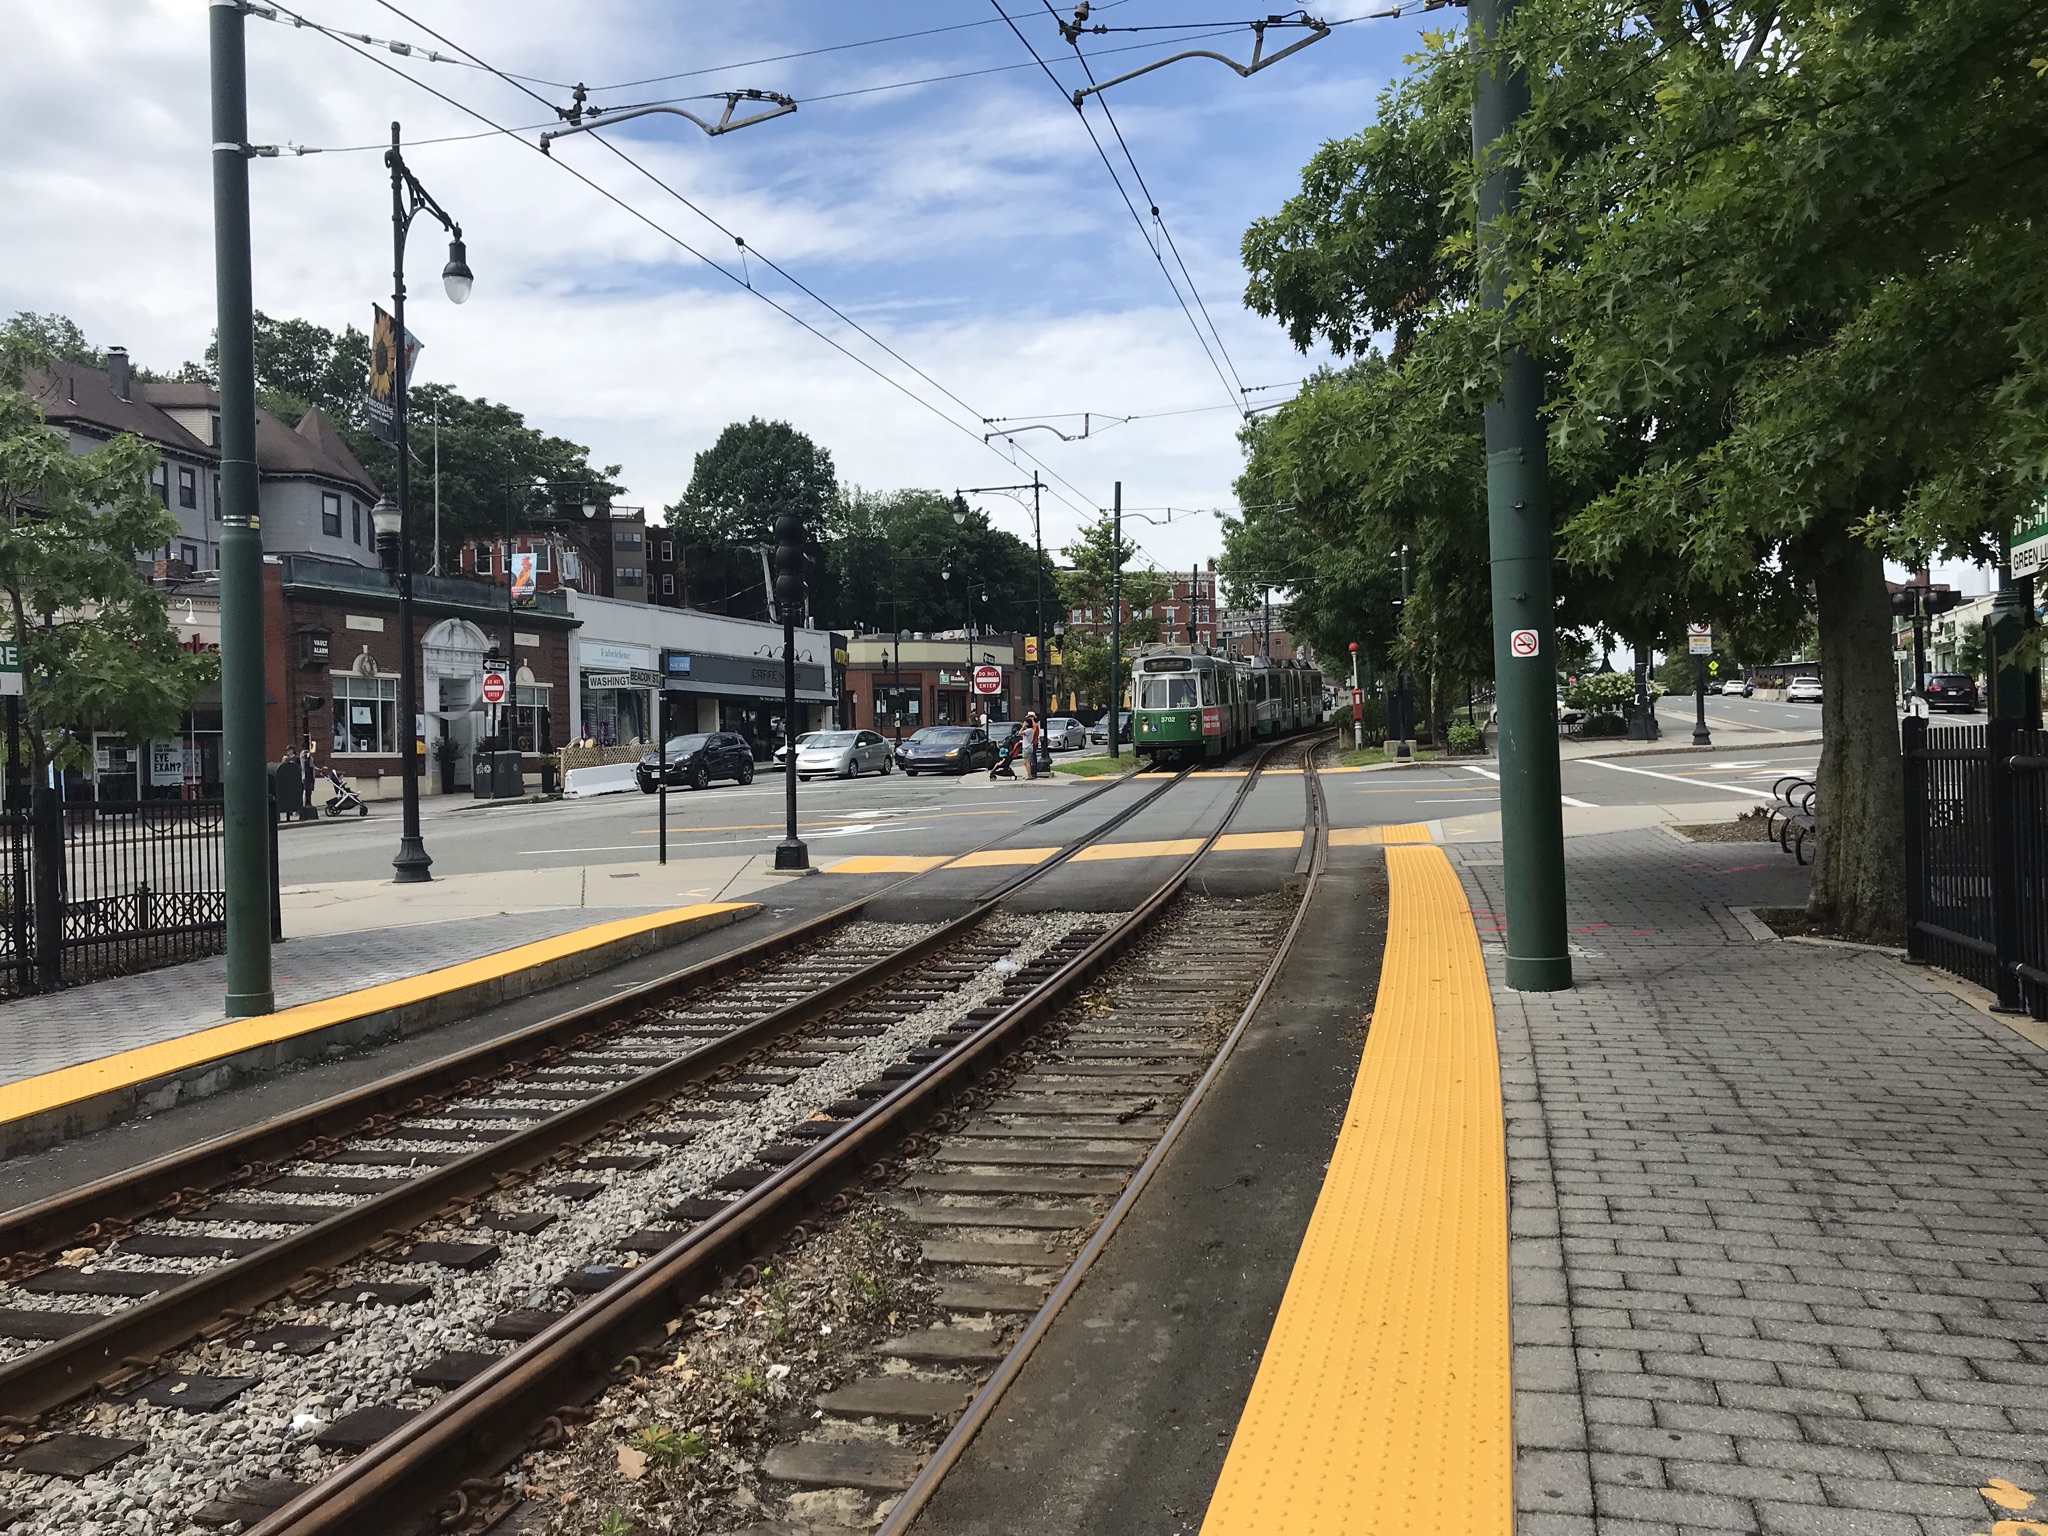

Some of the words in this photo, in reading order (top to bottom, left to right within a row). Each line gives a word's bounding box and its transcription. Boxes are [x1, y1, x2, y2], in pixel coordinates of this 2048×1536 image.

[2014, 546, 2038, 570] GREEN
[590, 676, 630, 687] WASHINGT
[631, 671, 651, 682] BEACON
[154, 753, 169, 762] EYE
[154, 762, 181, 772] EXAM?
